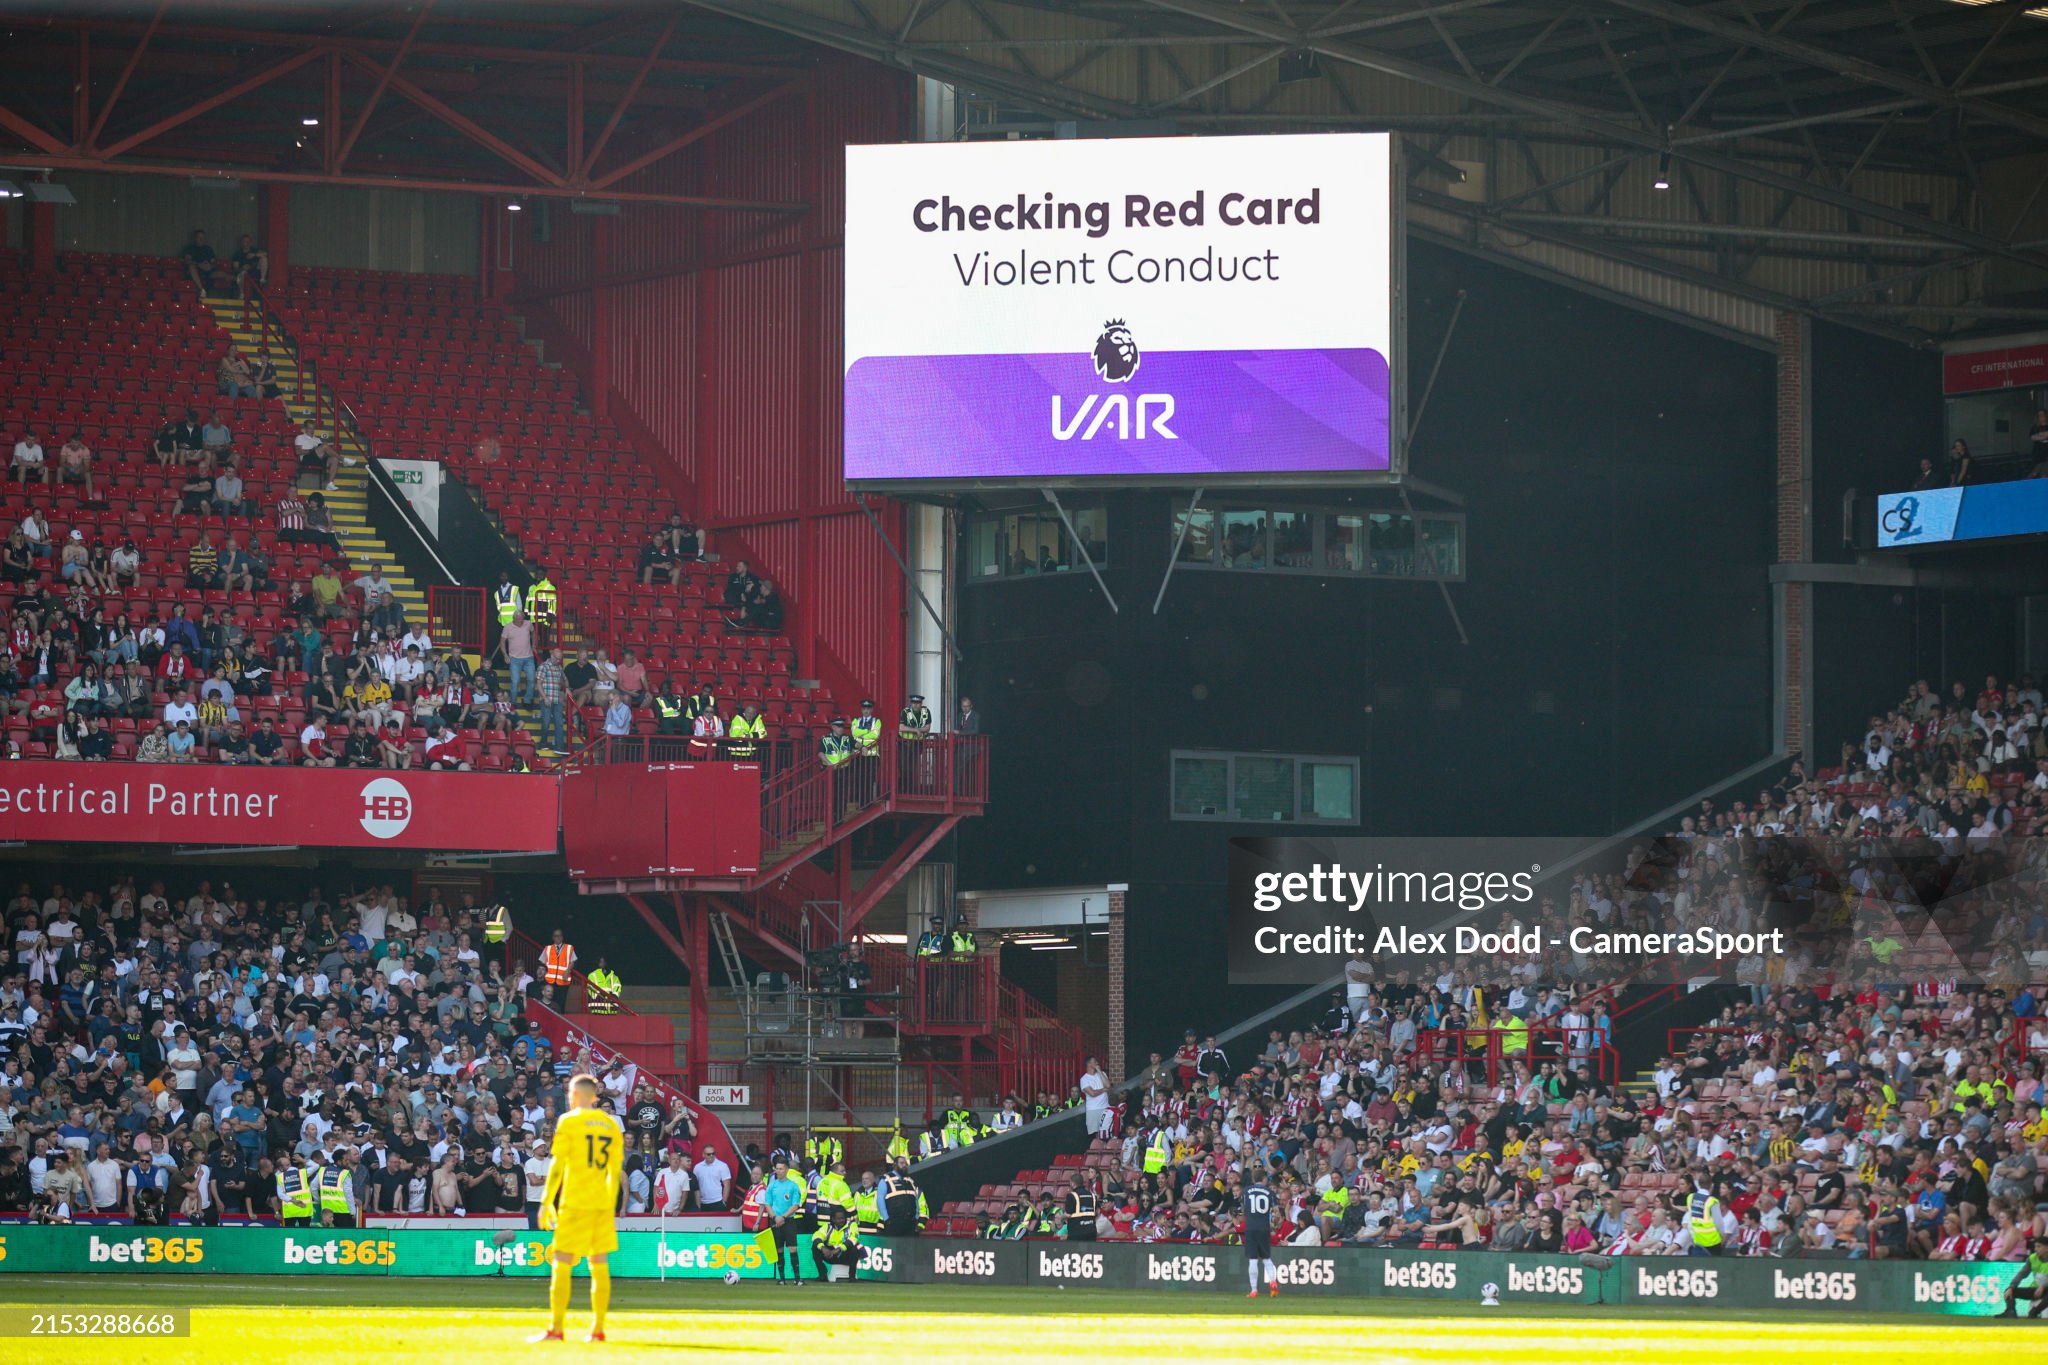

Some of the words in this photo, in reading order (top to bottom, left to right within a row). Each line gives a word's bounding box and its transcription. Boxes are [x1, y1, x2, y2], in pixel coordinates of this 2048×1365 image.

[913, 192, 1110, 238] Checking
[1125, 190, 1203, 227] Red
[1218, 188, 1320, 226] Card
[953, 249, 1096, 286] Violent
[1107, 245, 1280, 284] Conduct
[1970, 365, 1983, 374] CFI
[1985, 358, 2045, 373] INTERNATIONAL
[1051, 393, 1179, 441] VAR
[149, 783, 279, 817] Partner
[730, 1088, 743, 1103] M
[586, 1134, 613, 1169] 13
[1248, 1194, 1270, 1214] 10
[89, 1235, 204, 1263] bet365
[284, 1237, 396, 1266] bet365
[657, 1242, 762, 1268] bet365
[934, 1248, 995, 1276] bet365
[1039, 1250, 1104, 1279] bet365
[1148, 1253, 1216, 1282] bet365
[1384, 1258, 1457, 1289] bet365
[1508, 1263, 1583, 1294] bet365
[1638, 1267, 1719, 1298] bet365
[1774, 1269, 1856, 1301] bet365
[1914, 1272, 2000, 1304] bet365
